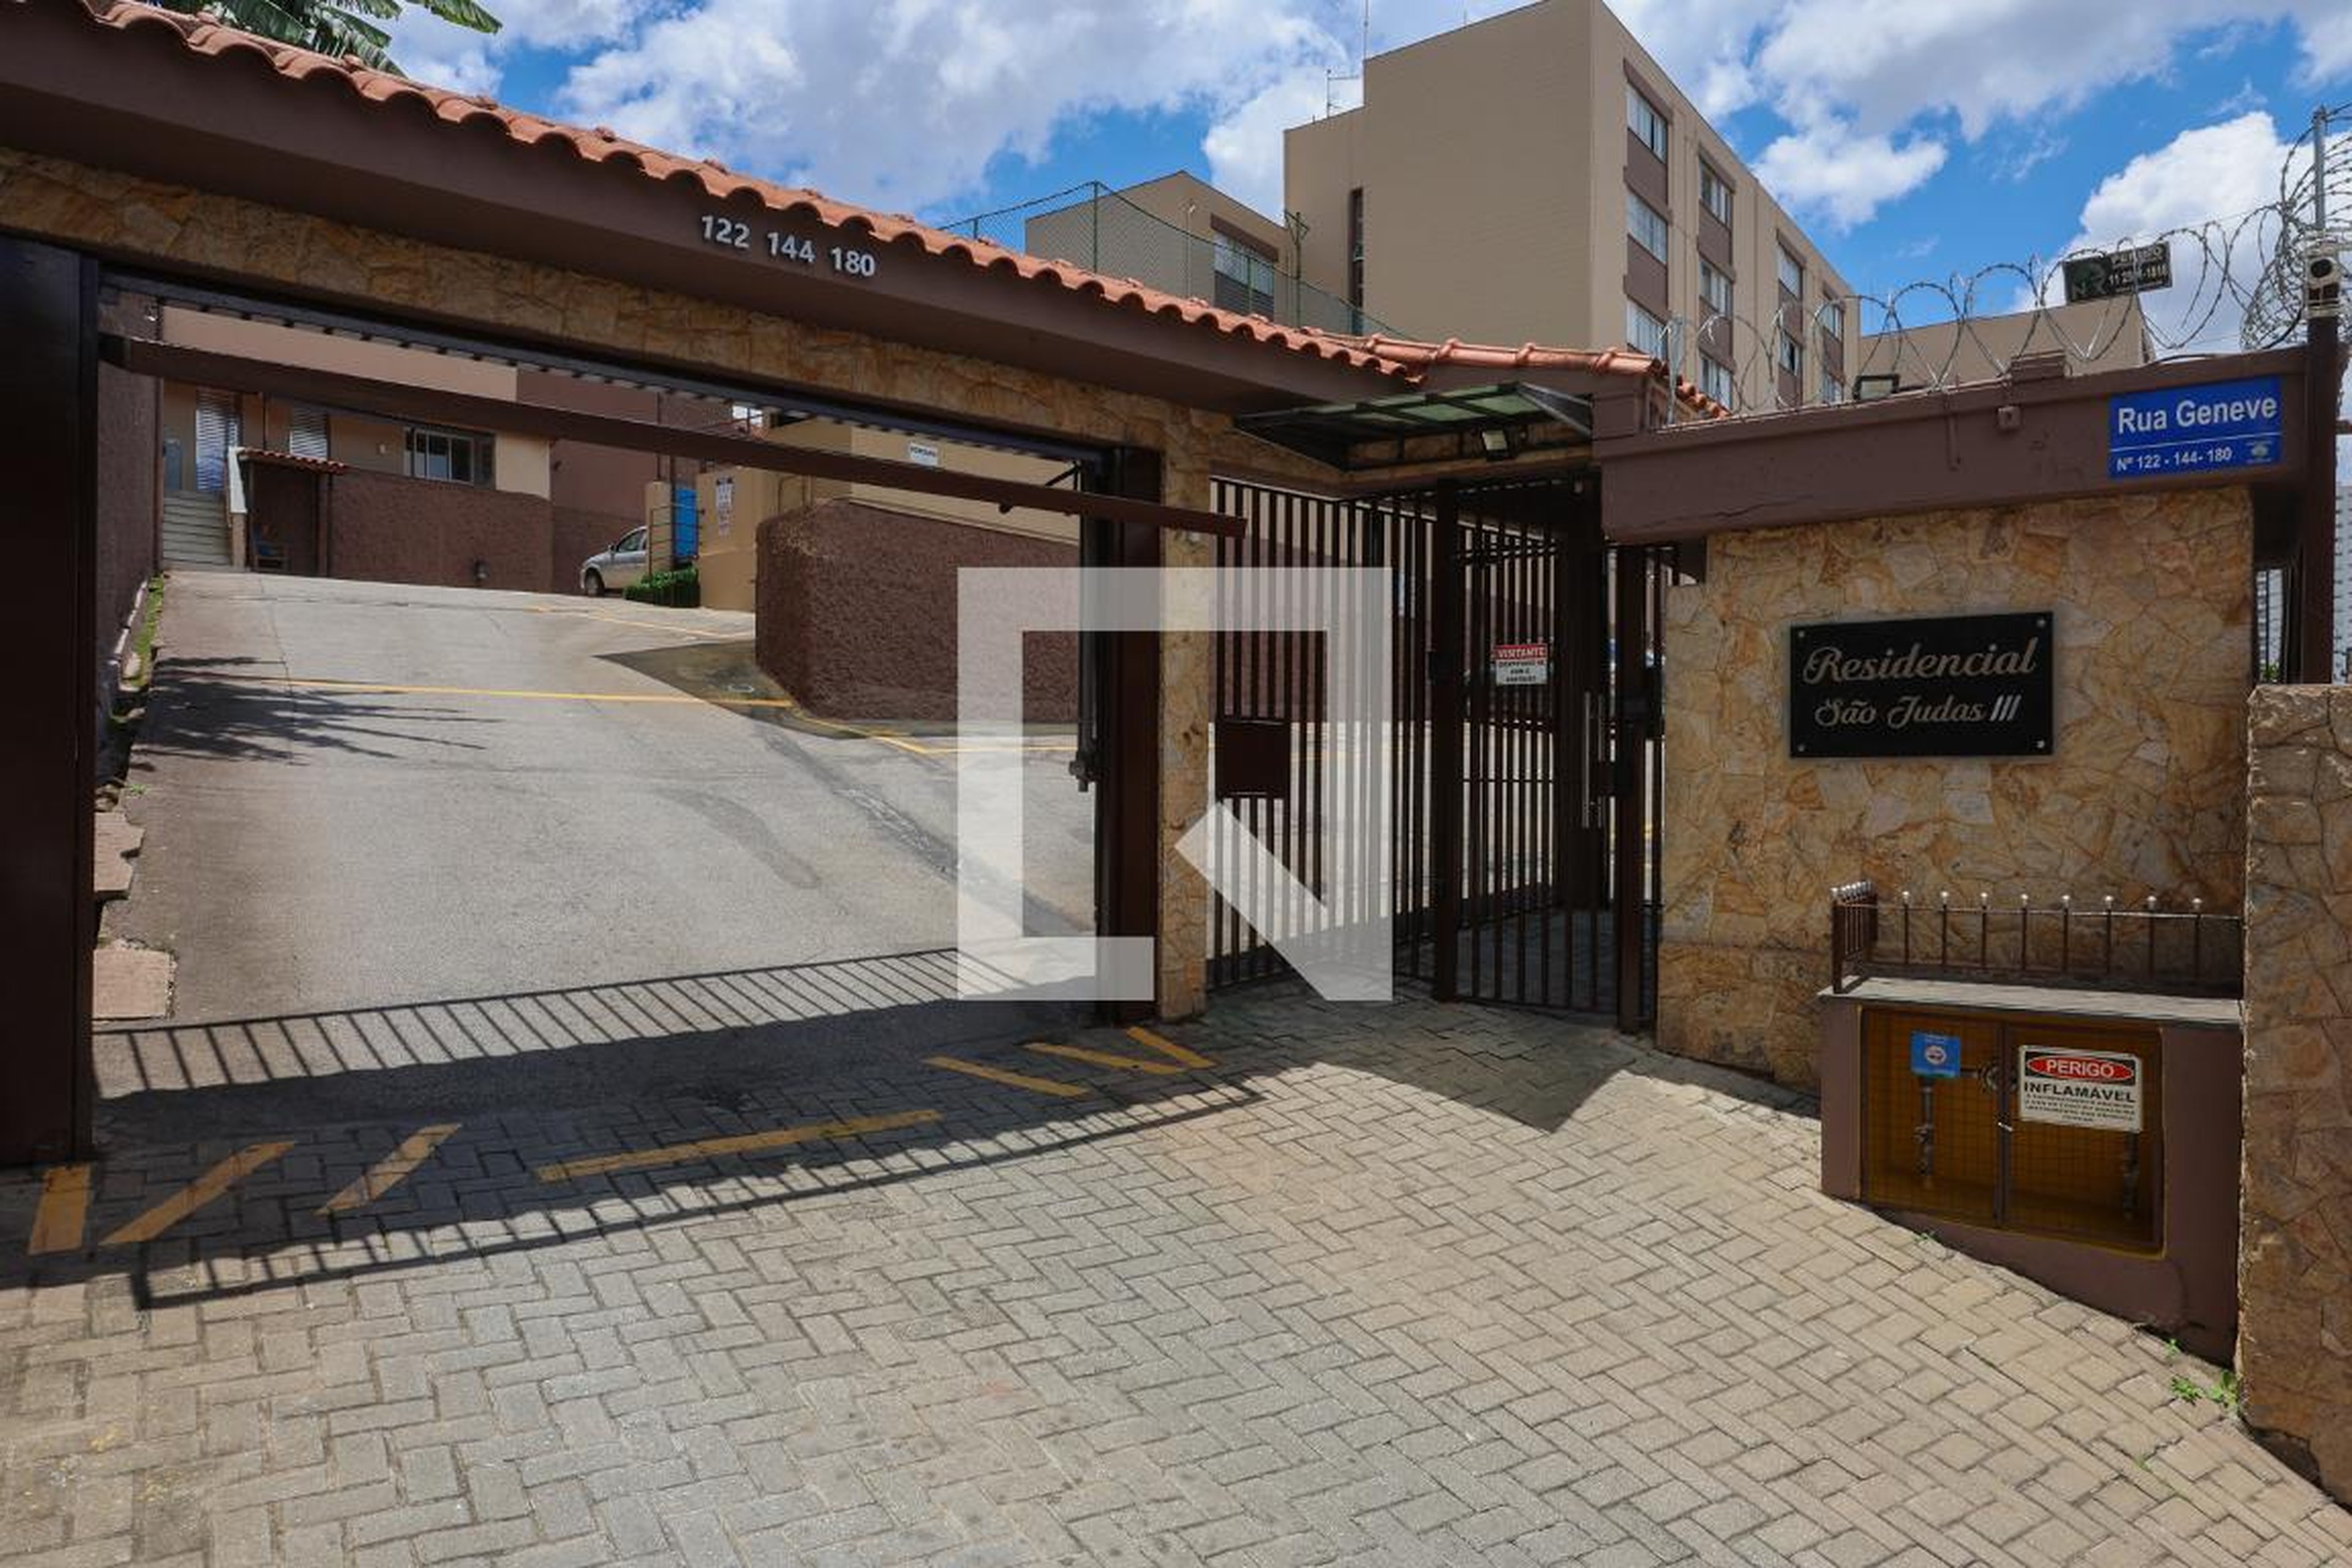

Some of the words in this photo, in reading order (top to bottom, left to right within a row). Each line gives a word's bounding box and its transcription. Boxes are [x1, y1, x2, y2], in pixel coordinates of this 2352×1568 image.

[701, 215, 750, 248] 122
[767, 232, 816, 263] 144
[831, 246, 875, 276] 180
[2117, 407, 2167, 434] Rua
[2176, 397, 2277, 427] Geneve
[2138, 454, 2161, 470] 122
[2206, 446, 2232, 462] 180
[1803, 636, 2038, 684] Residencial
[1815, 699, 1876, 727] São
[1887, 694, 1987, 729] Judas
[1988, 693, 2022, 722] III
[2046, 1058, 2114, 1078] PERIGO
[2024, 1081, 2136, 1102] INFLAMÁVEL
